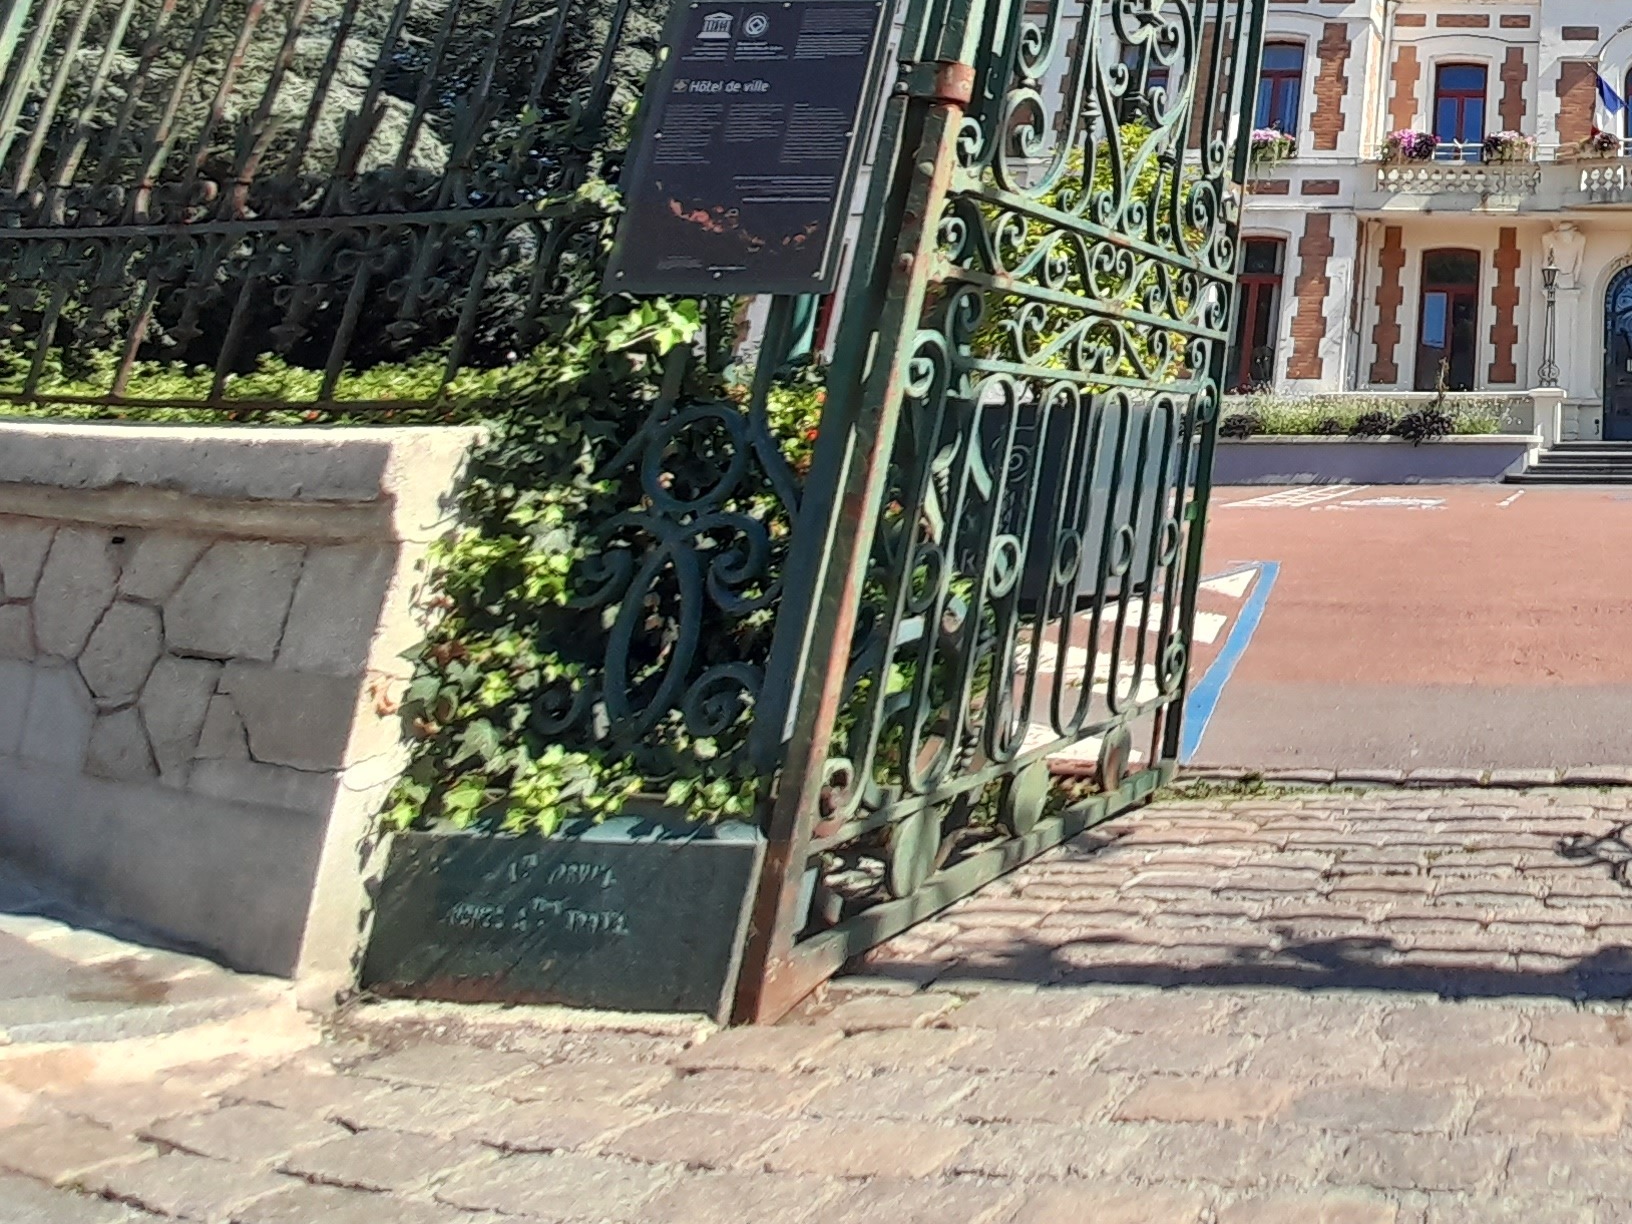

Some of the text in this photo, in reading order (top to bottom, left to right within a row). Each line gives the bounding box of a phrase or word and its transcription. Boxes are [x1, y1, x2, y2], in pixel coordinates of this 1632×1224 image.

[688, 79, 770, 93] Hôtel de ville
